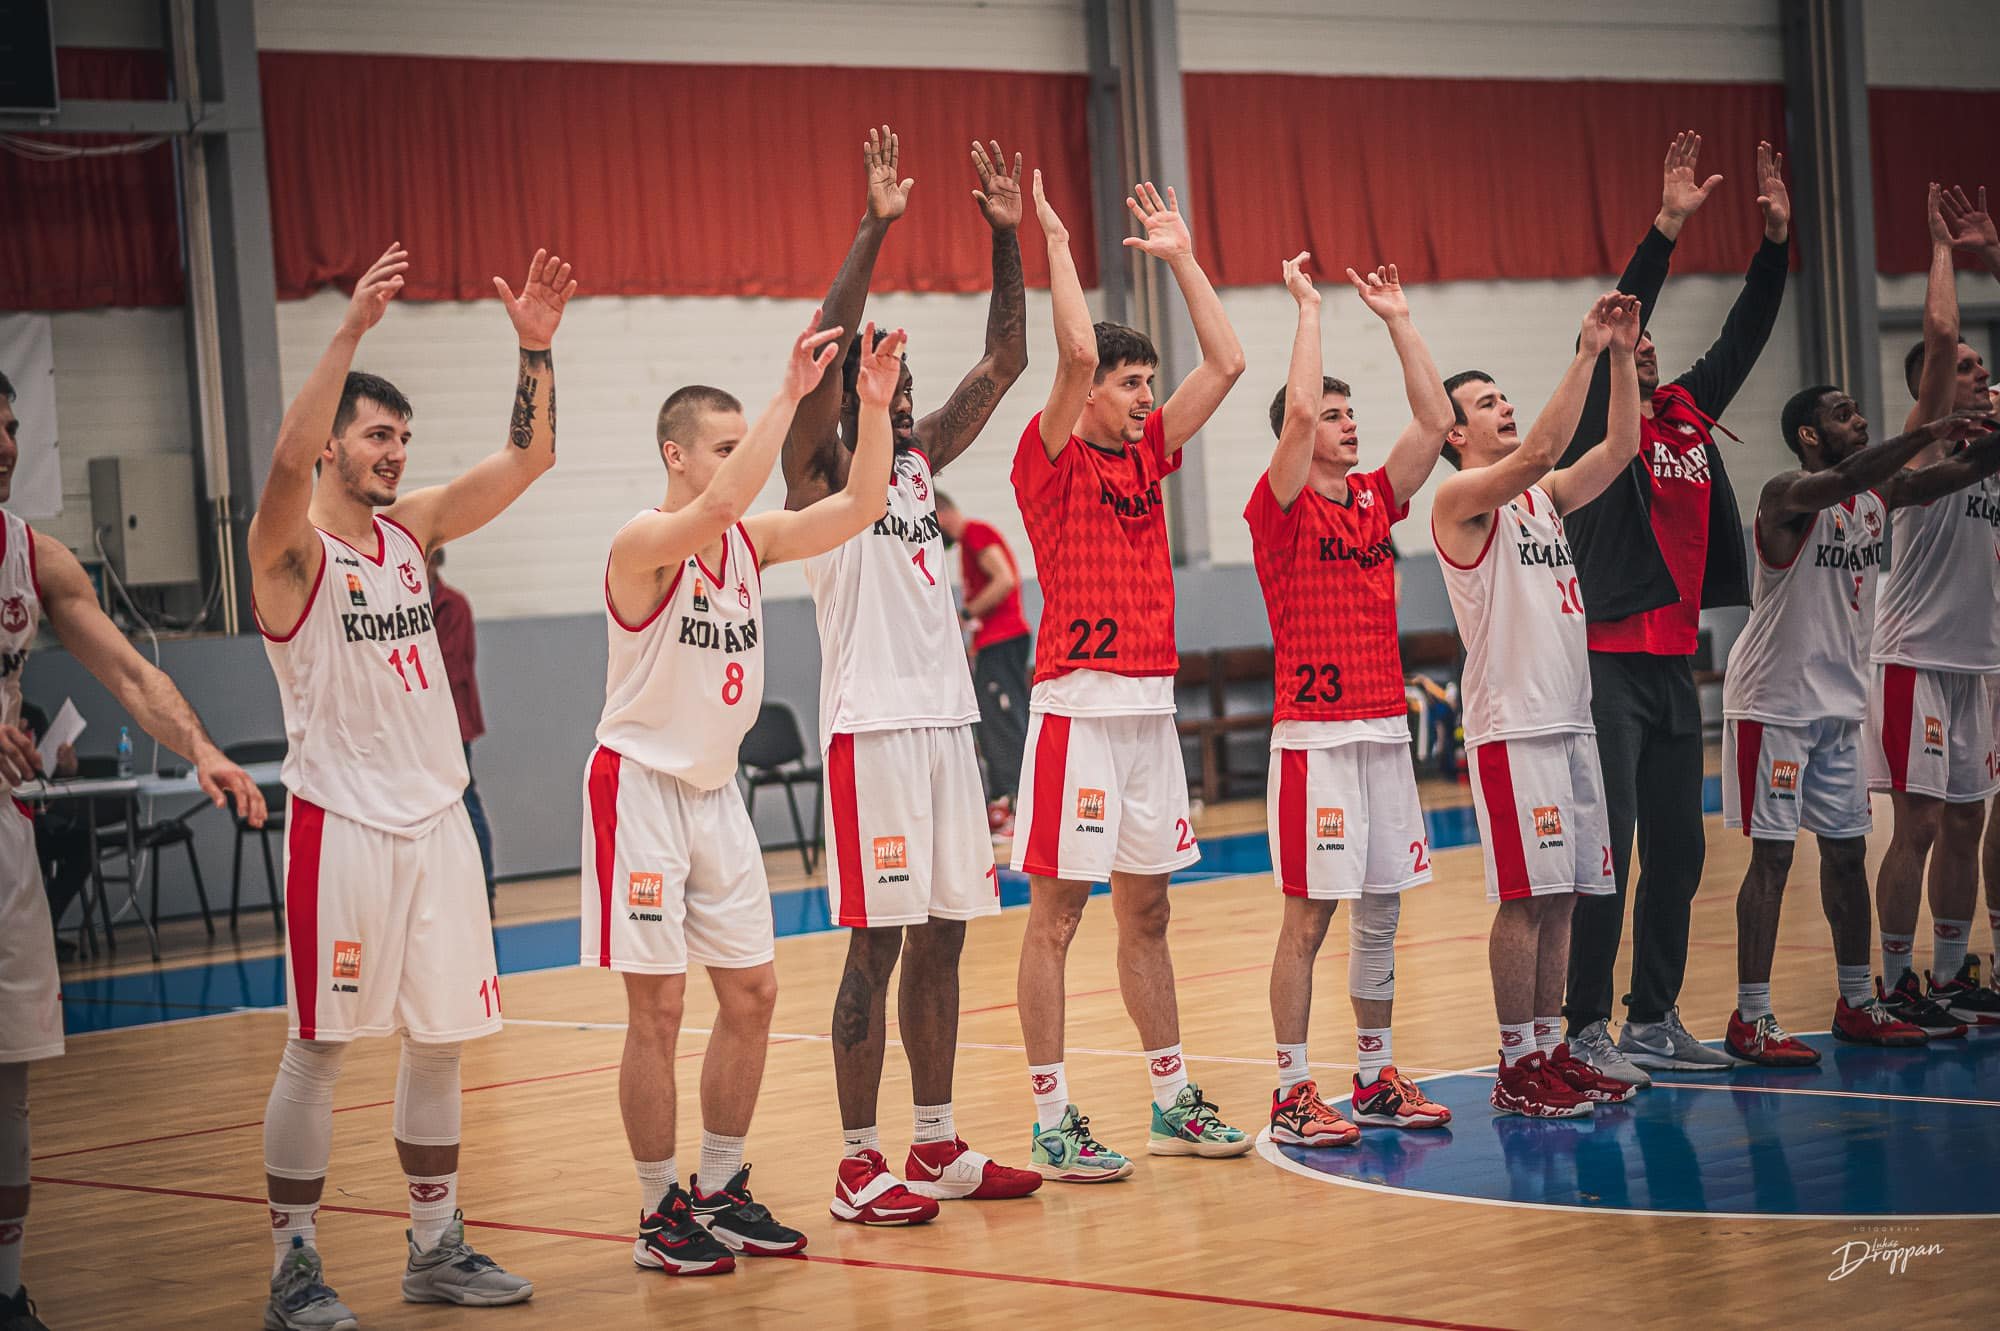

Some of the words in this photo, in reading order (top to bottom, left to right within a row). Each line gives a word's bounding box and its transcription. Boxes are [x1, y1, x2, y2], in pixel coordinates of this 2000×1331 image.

[911, 547, 936, 586] 1
[1067, 617, 1119, 661] 22
[388, 644, 429, 693] 11
[721, 662, 745, 706] 8
[1295, 663, 1342, 704] 23
[479, 975, 501, 1018] 11
